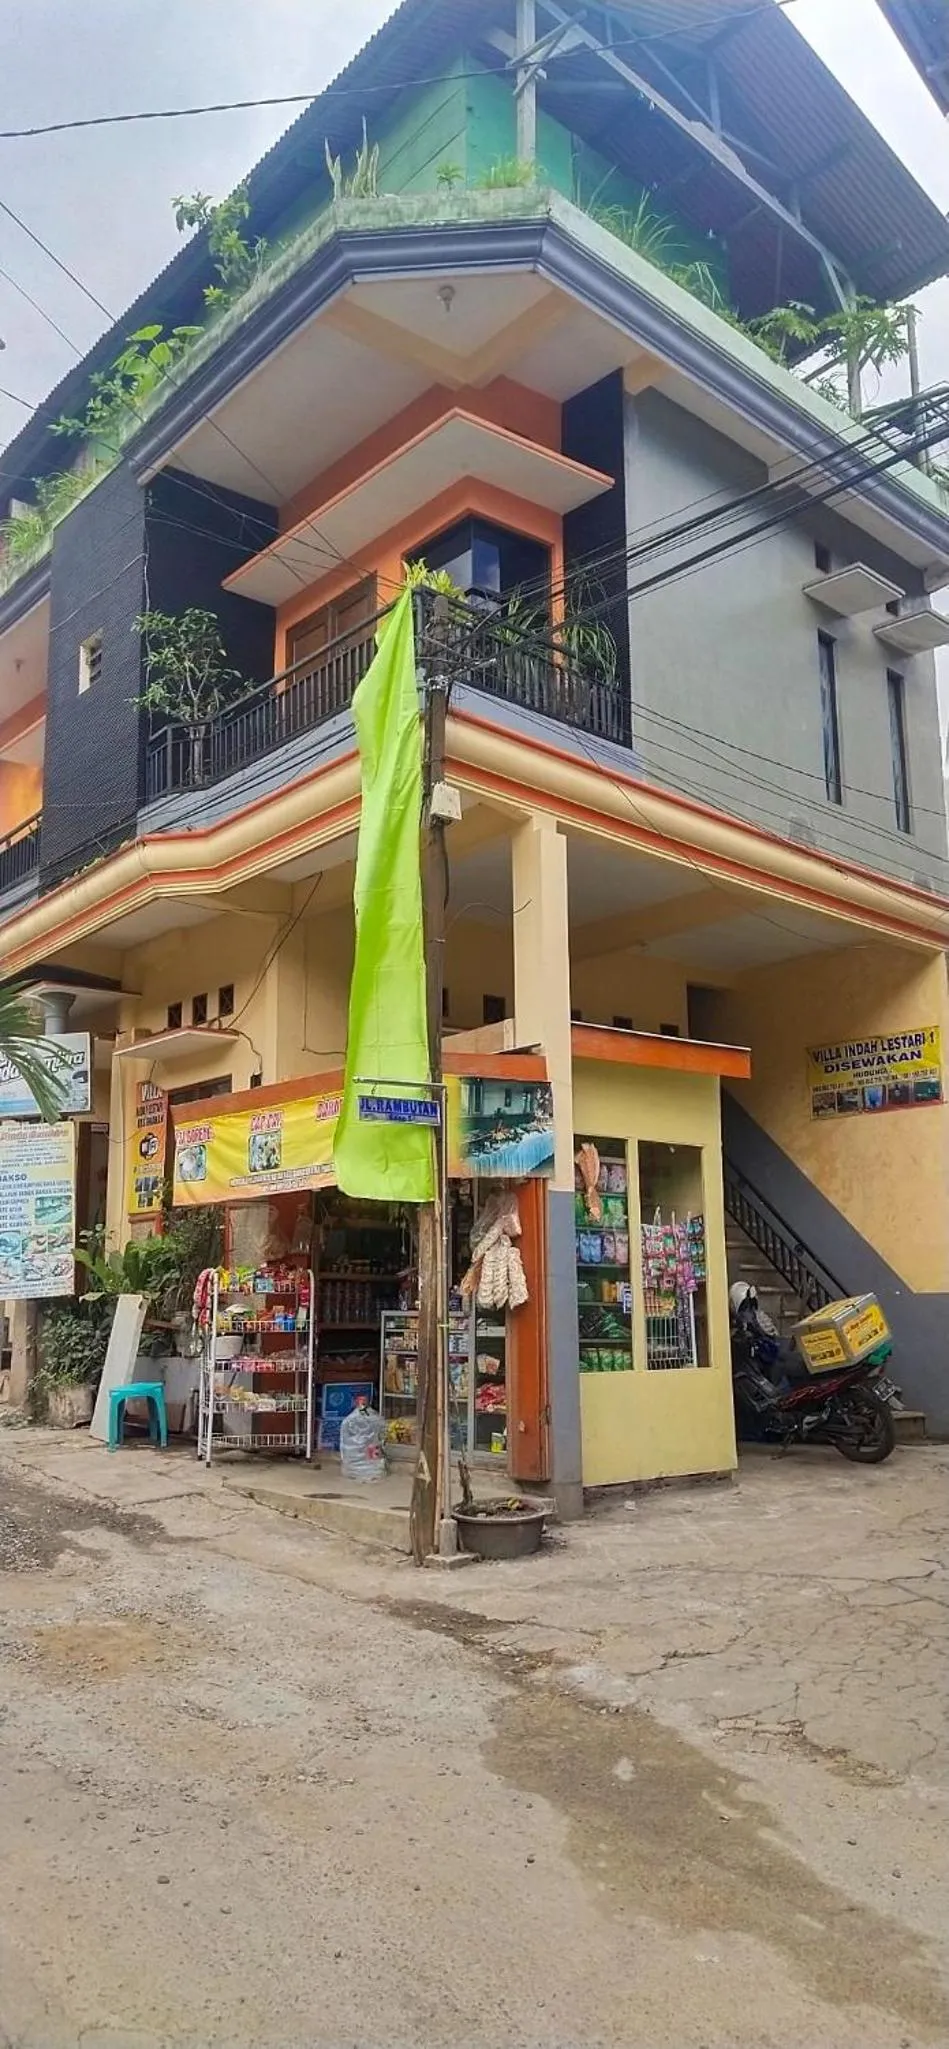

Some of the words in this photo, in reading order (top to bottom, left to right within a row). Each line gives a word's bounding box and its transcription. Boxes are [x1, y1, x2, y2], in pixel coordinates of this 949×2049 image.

[812, 1046, 842, 1062] VILLA
[844, 1039, 878, 1057] INDAH
[881, 1032, 926, 1052] LESTARI
[824, 1050, 922, 1074] DISEWAKAN
[0, 1173, 27, 1182] AKSO
